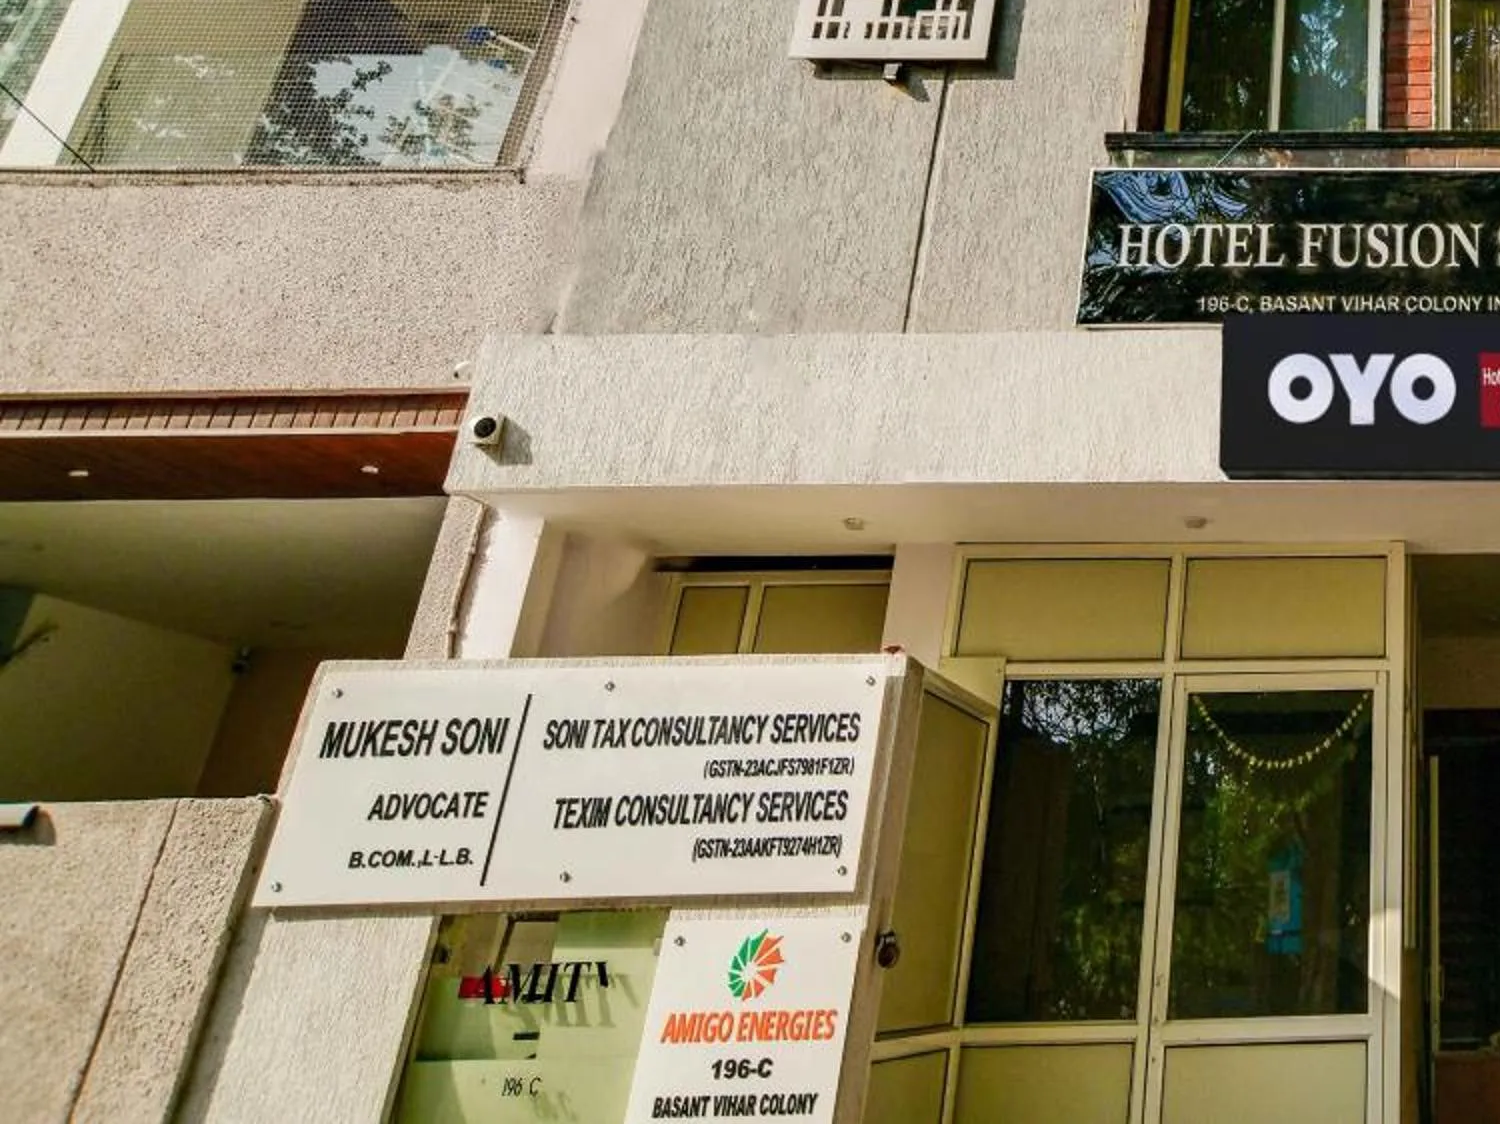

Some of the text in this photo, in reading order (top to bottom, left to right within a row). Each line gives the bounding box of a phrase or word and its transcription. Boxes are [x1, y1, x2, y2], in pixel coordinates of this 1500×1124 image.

[1117, 223, 1286, 268] HOTEL
[1298, 223, 1483, 268] FUSION
[1198, 295, 1253, 315] 196-C,
[1260, 295, 1336, 312] BASANT
[1341, 295, 1399, 312] VIHAR
[1405, 295, 1483, 312] COLONY
[1267, 352, 1456, 425] OYO
[319, 717, 510, 758] MUKESH SONI
[543, 712, 861, 750] SONI TAX CONSULTANCY SERVICES
[367, 791, 489, 820] ADVOCATE
[554, 789, 849, 829] TEXIM CONSULTANCY SERVICES
[660, 1009, 838, 1044] AMIGO ENERGIES
[711, 1058, 774, 1079] 196-C
[652, 1092, 818, 1119] BASANT VIHAR COLONY
